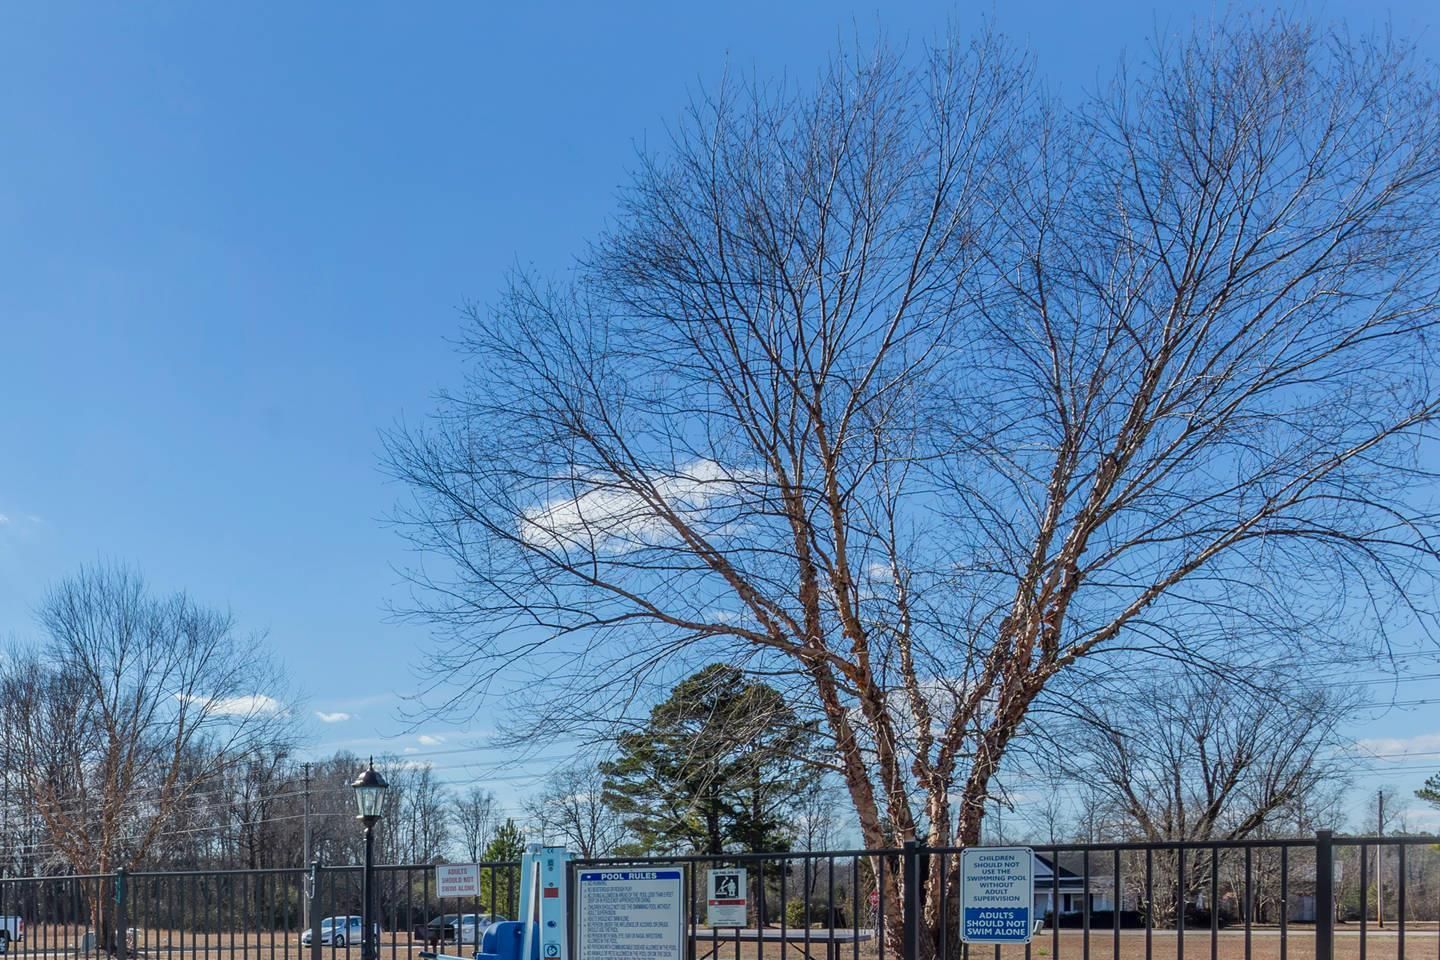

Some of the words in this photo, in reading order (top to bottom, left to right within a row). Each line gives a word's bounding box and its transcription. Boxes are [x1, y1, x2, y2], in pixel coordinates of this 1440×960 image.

[628, 872, 657, 880] RULES
[979, 911, 1014, 919] ADULTS
[994, 928, 1026, 936] ALONE
